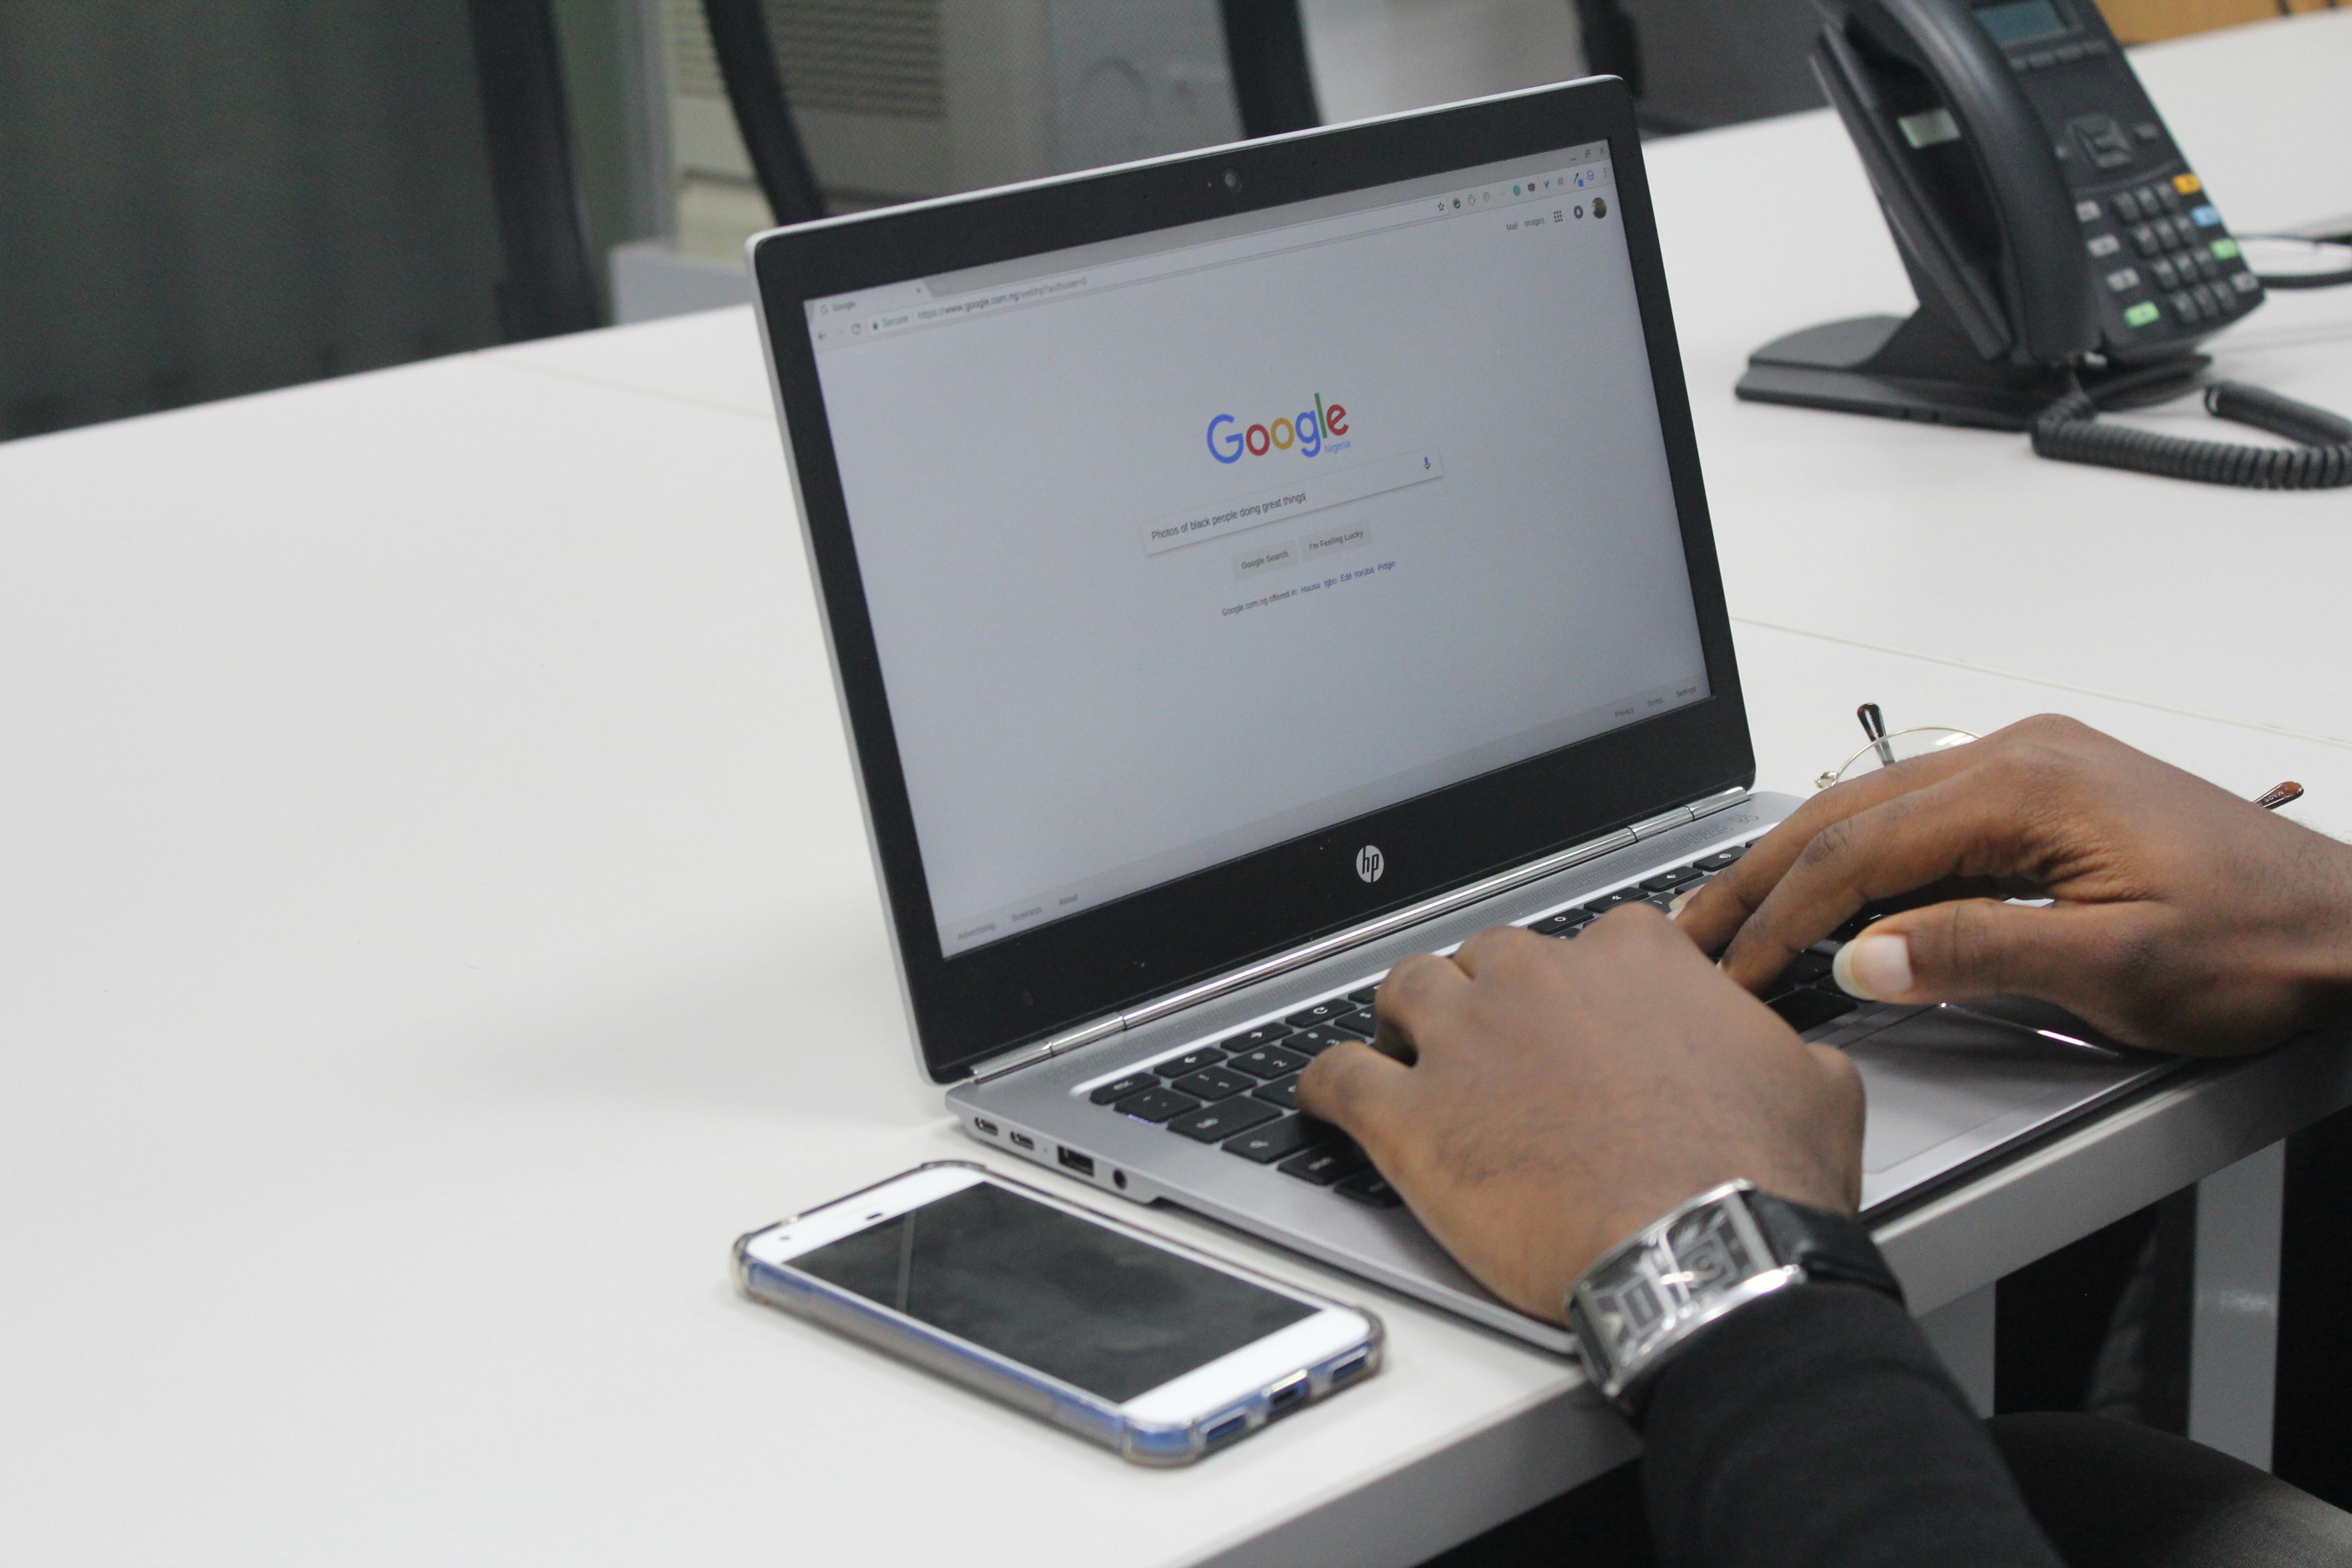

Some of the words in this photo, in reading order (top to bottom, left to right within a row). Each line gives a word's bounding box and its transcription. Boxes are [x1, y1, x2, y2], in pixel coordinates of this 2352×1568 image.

[1506, 222, 1518, 231] Mail
[1524, 217, 1544, 227] Images
[1207, 392, 1349, 464] Google
[1324, 440, 1351, 453] Nigeria
[1152, 527, 1179, 540] Photos
[1181, 522, 1188, 533] of
[1190, 517, 1210, 530] black
[1213, 511, 1237, 526] people
[1240, 505, 1260, 517] doing
[1262, 499, 1281, 513] great
[1283, 493, 1306, 505] things
[1320, 535, 1343, 548] Feeling
[1344, 530, 1363, 541] Lucky
[1241, 558, 1264, 569] Google
[1266, 550, 1289, 562] Search
[1222, 598, 1268, 616] Google.com.ng
[1269, 590, 1290, 603] offered
[1301, 583, 1320, 593] Hausa
[1324, 578, 1337, 588] Igbo
[1377, 561, 1396, 571] Pidgin
[1615, 707, 1634, 718] Privacy
[2264, 790, 2284, 803] MADE
[1362, 845, 1380, 882] hp
